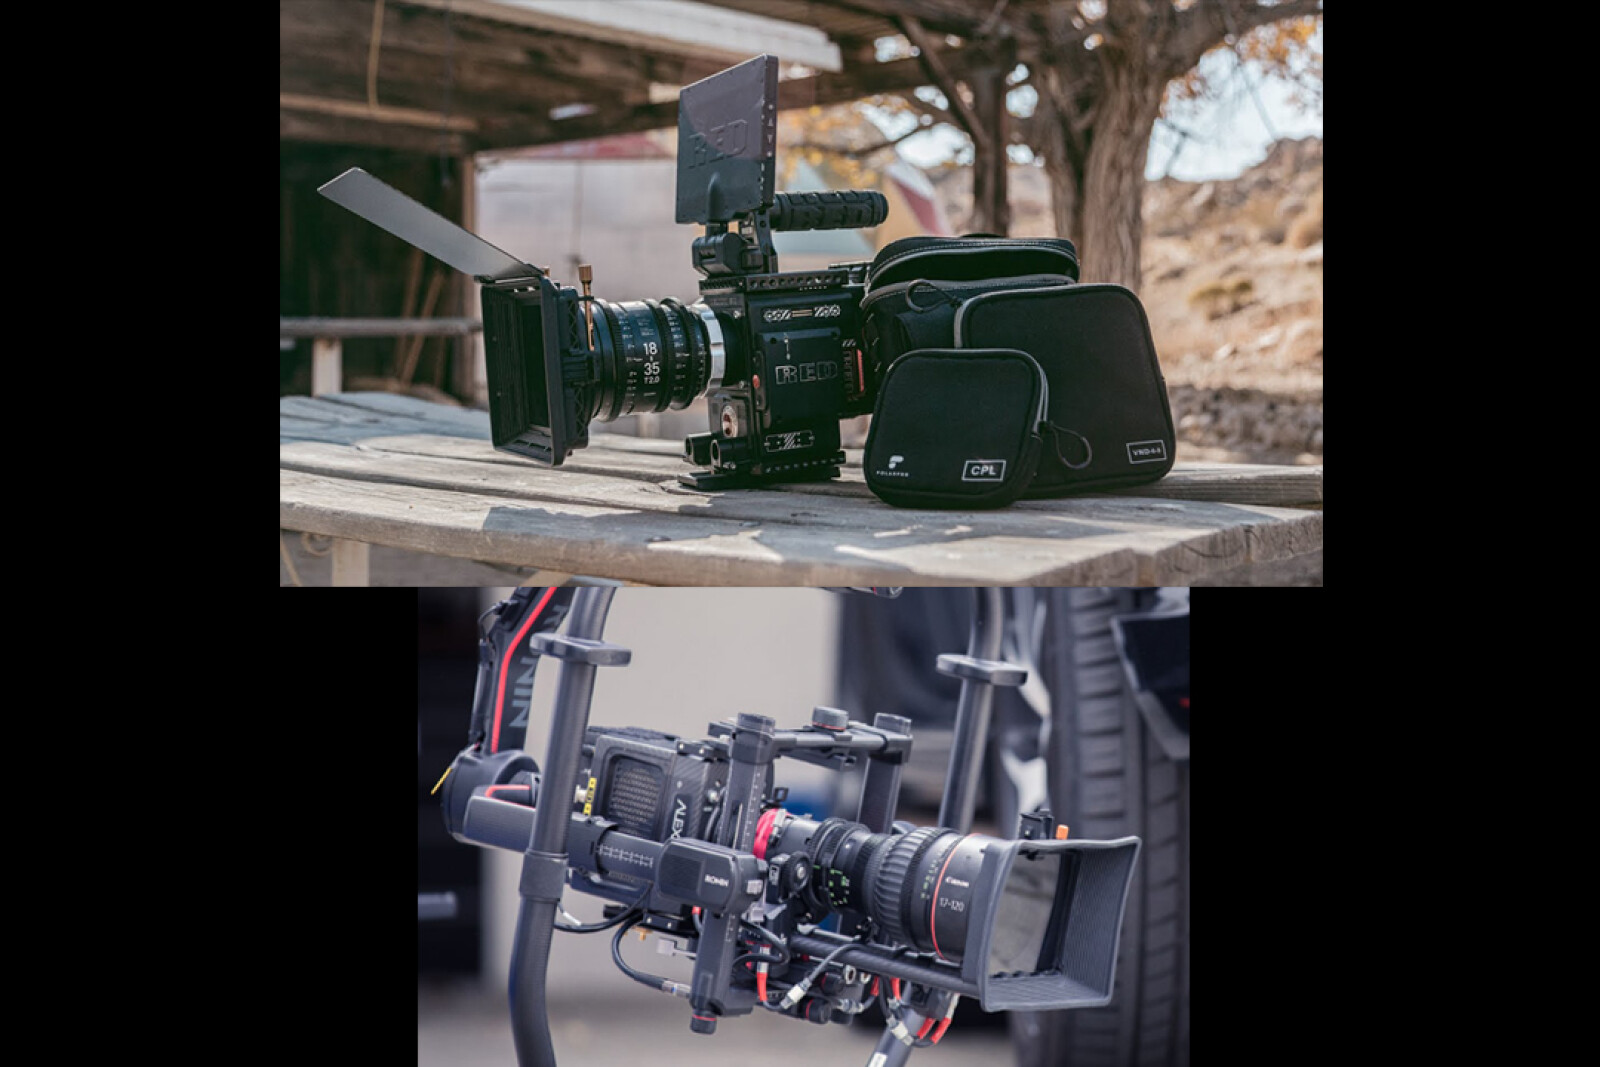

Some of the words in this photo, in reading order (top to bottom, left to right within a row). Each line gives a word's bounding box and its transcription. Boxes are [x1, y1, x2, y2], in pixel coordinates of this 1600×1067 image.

[643, 341, 658, 355] 18
[644, 361, 660, 376] 35
[775, 361, 838, 385] RED
[971, 465, 997, 476] CPL
